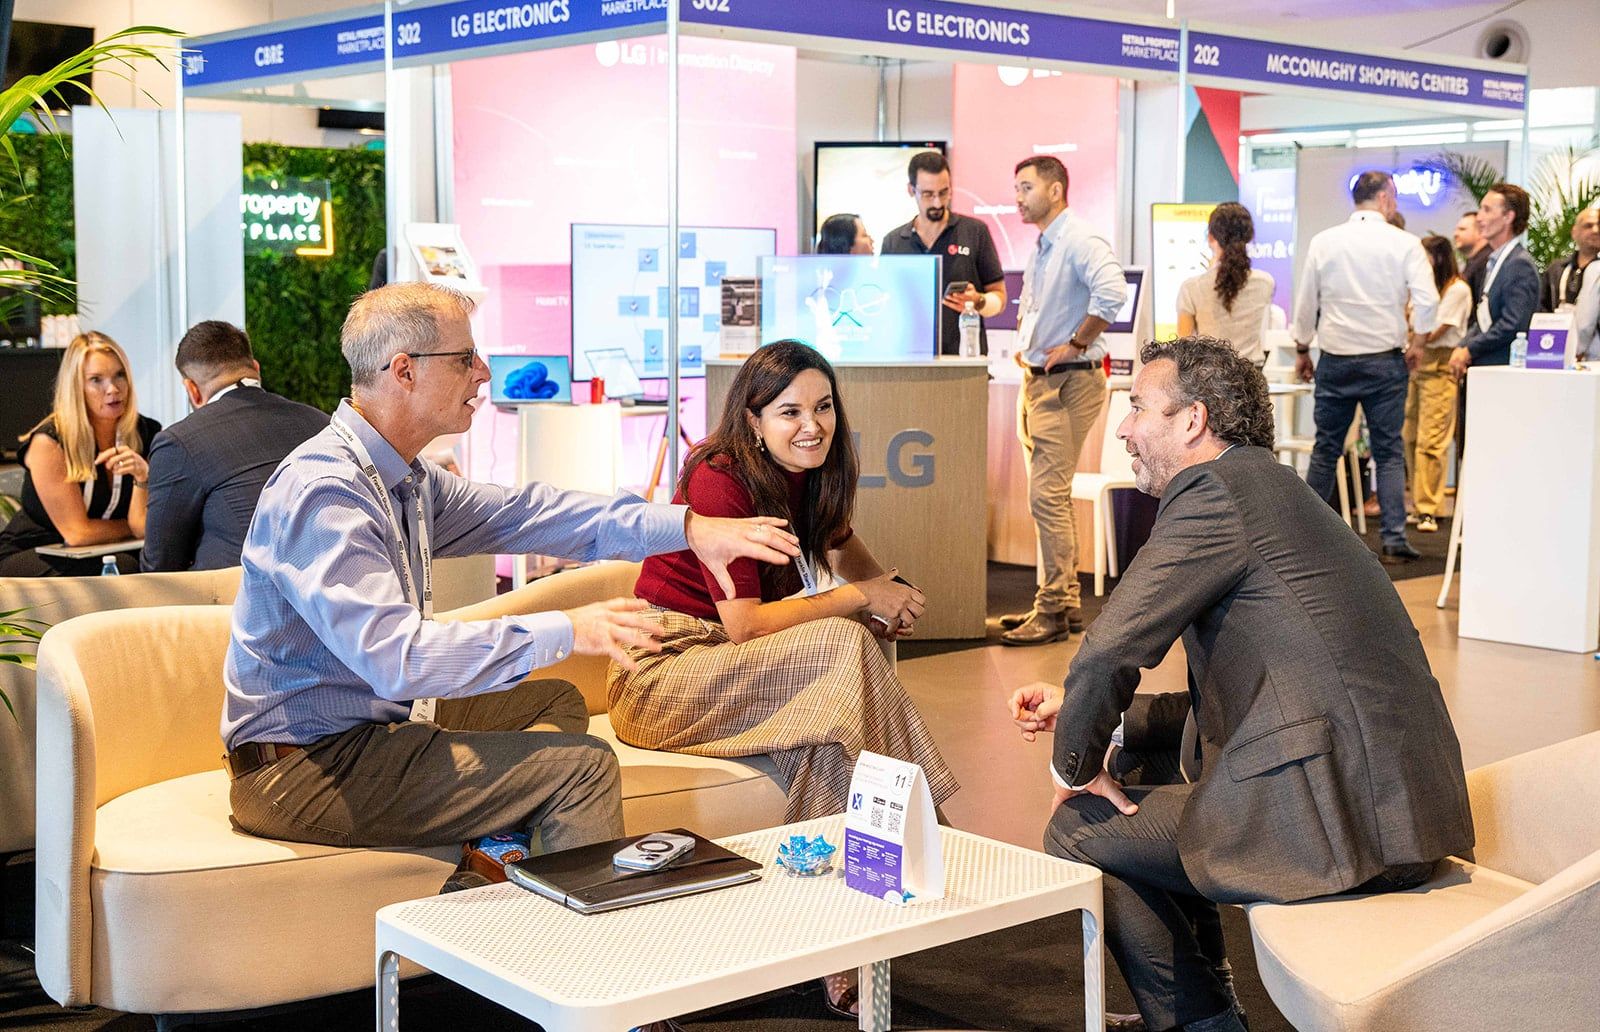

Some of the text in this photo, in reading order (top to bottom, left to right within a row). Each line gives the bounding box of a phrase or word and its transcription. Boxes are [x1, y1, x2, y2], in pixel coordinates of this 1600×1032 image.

[451, 0, 571, 38] LG ELECTRONICS
[886, 8, 1030, 46] LG ELECTRONICS
[397, 22, 421, 46] 302
[1122, 34, 1145, 46] RETAIL
[620, 43, 647, 65] LG
[1122, 45, 1179, 62] MARKETPLACE
[1193, 43, 1220, 66] 202
[1266, 53, 1469, 96] MCCONAGHY SHOPPING CENTRES
[958, 245, 970, 256] LG
[850, 429, 935, 488] LG
[371, 475, 392, 517] Franklin Shanks
[423, 548, 431, 567] Shanks
[895, 774, 907, 789] 11
